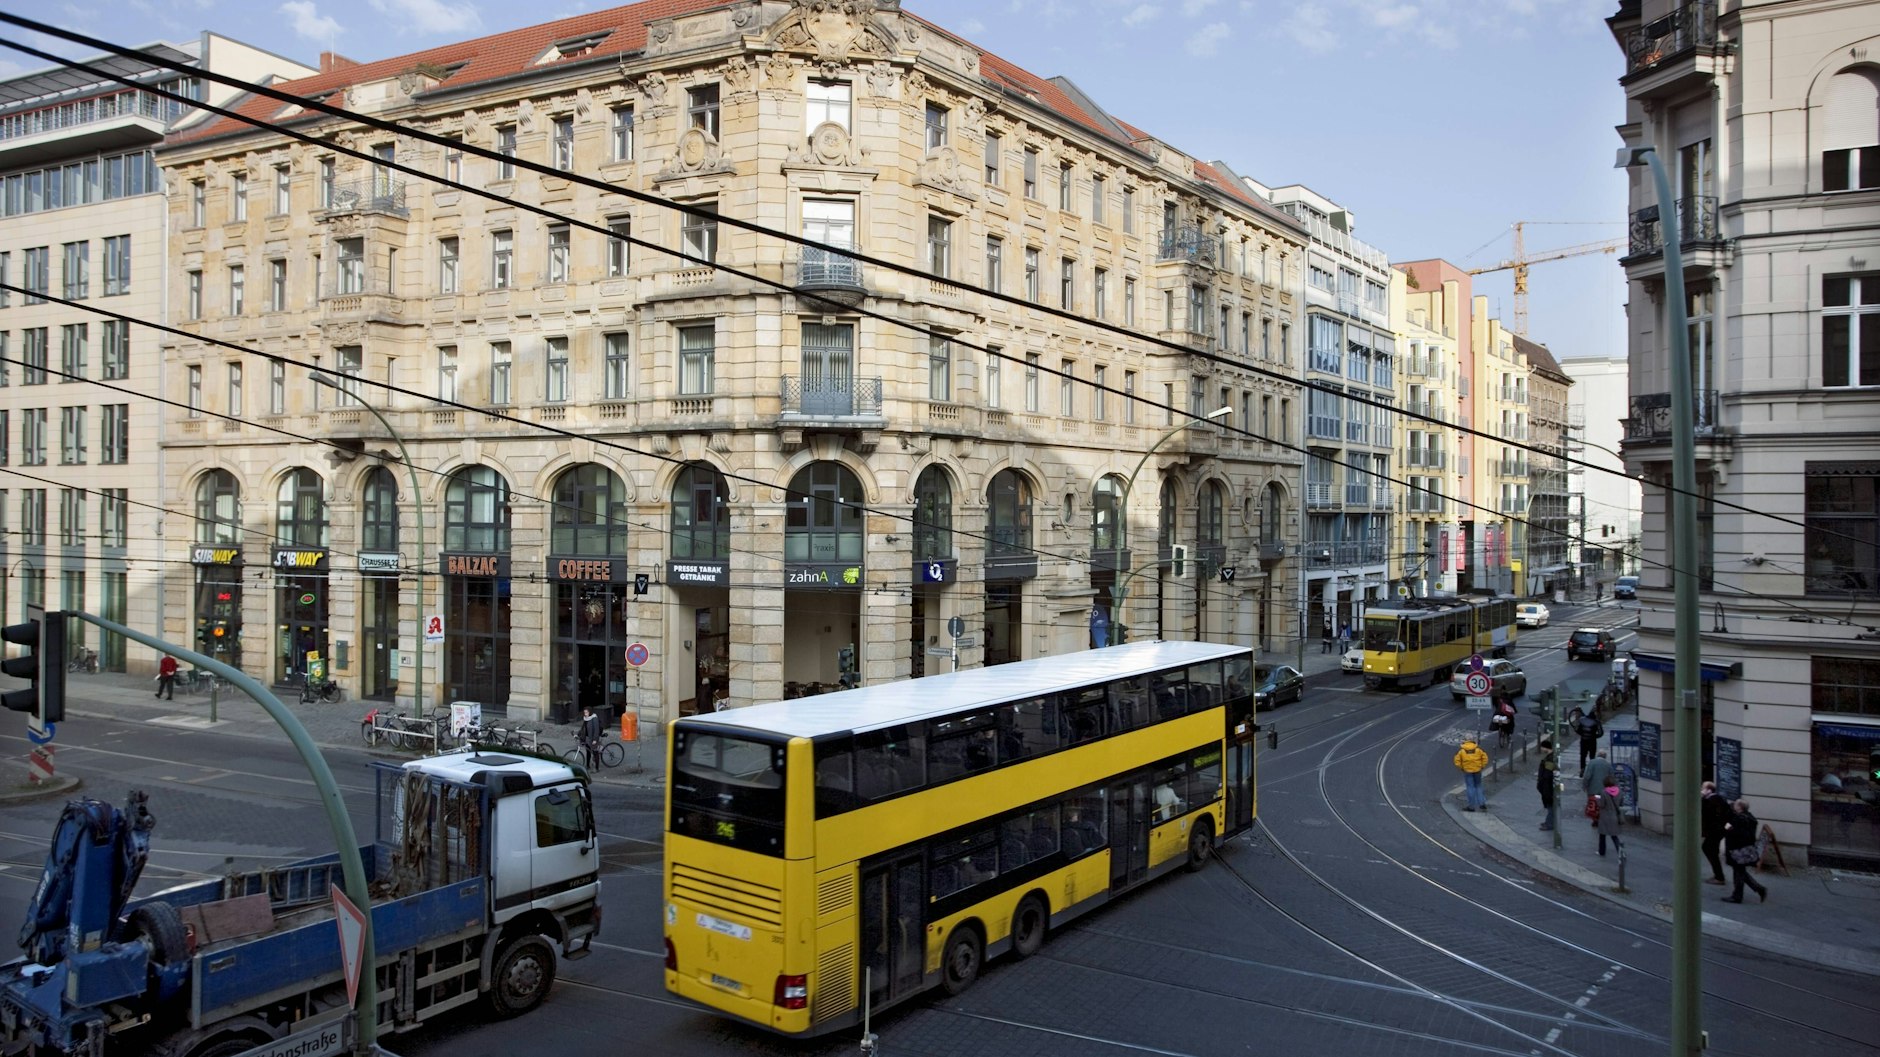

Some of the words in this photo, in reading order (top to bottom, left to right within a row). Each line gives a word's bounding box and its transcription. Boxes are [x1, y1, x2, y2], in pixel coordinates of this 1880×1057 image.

[192, 549, 238, 564] SUBWAY
[274, 551, 323, 567] SUBWAY
[448, 556, 497, 575] BALZAC
[559, 559, 610, 580] COFFEE
[674, 565, 698, 573] PRESSE
[699, 566, 722, 574] TABAK
[680, 572, 716, 582] GETRÄNKE
[789, 569, 829, 583] zahnA
[1471, 678, 1485, 690] 30
[257, 1031, 337, 1057] nstraße
